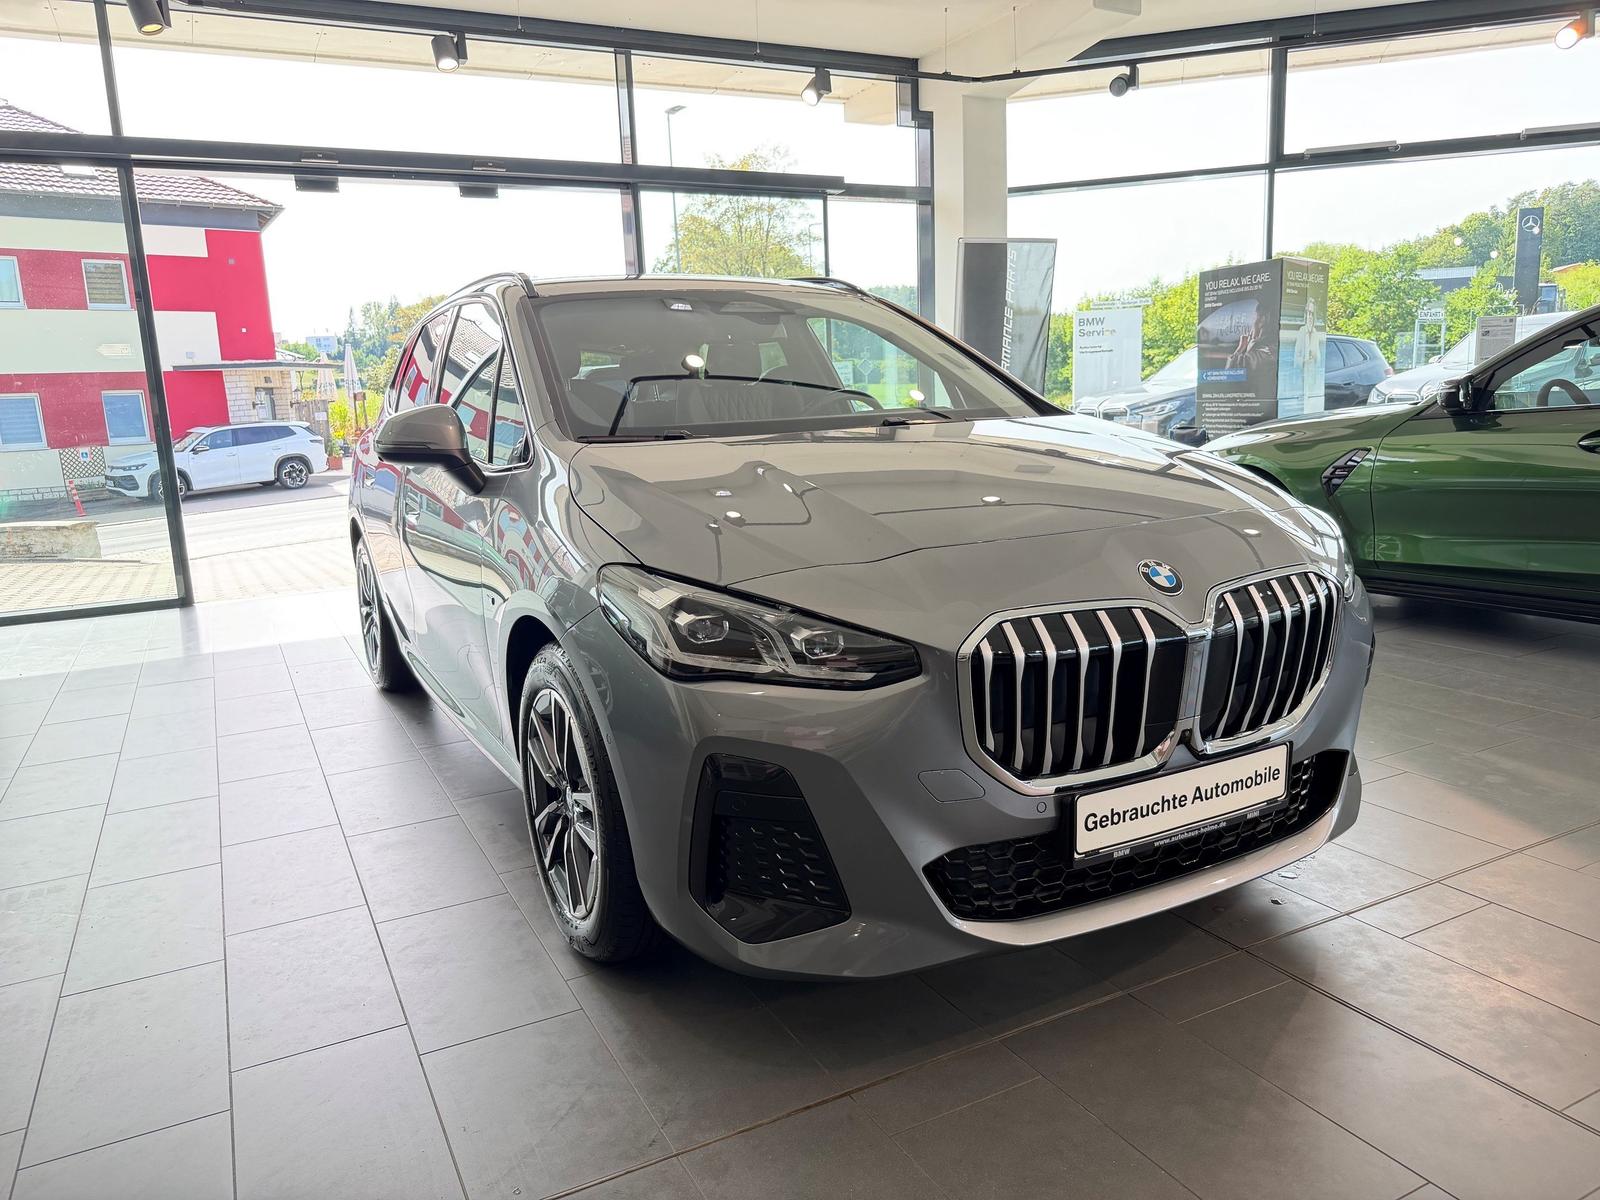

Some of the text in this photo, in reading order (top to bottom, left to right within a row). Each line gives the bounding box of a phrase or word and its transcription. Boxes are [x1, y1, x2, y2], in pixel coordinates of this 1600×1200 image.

[1205, 280, 1218, 291] YOU
[1219, 277, 1240, 289] RELAX.
[1241, 275, 1252, 285] WE
[1252, 272, 1271, 284] CARE.
[1000, 248, 1017, 374] RMANCE PARTS
[1078, 317, 1105, 327] BMW
[1078, 327, 1117, 337] Service
[1084, 764, 1281, 833] Gebrauchte Automobile
[1246, 810, 1260, 819] MINI
[1113, 848, 1131, 858] BMW
